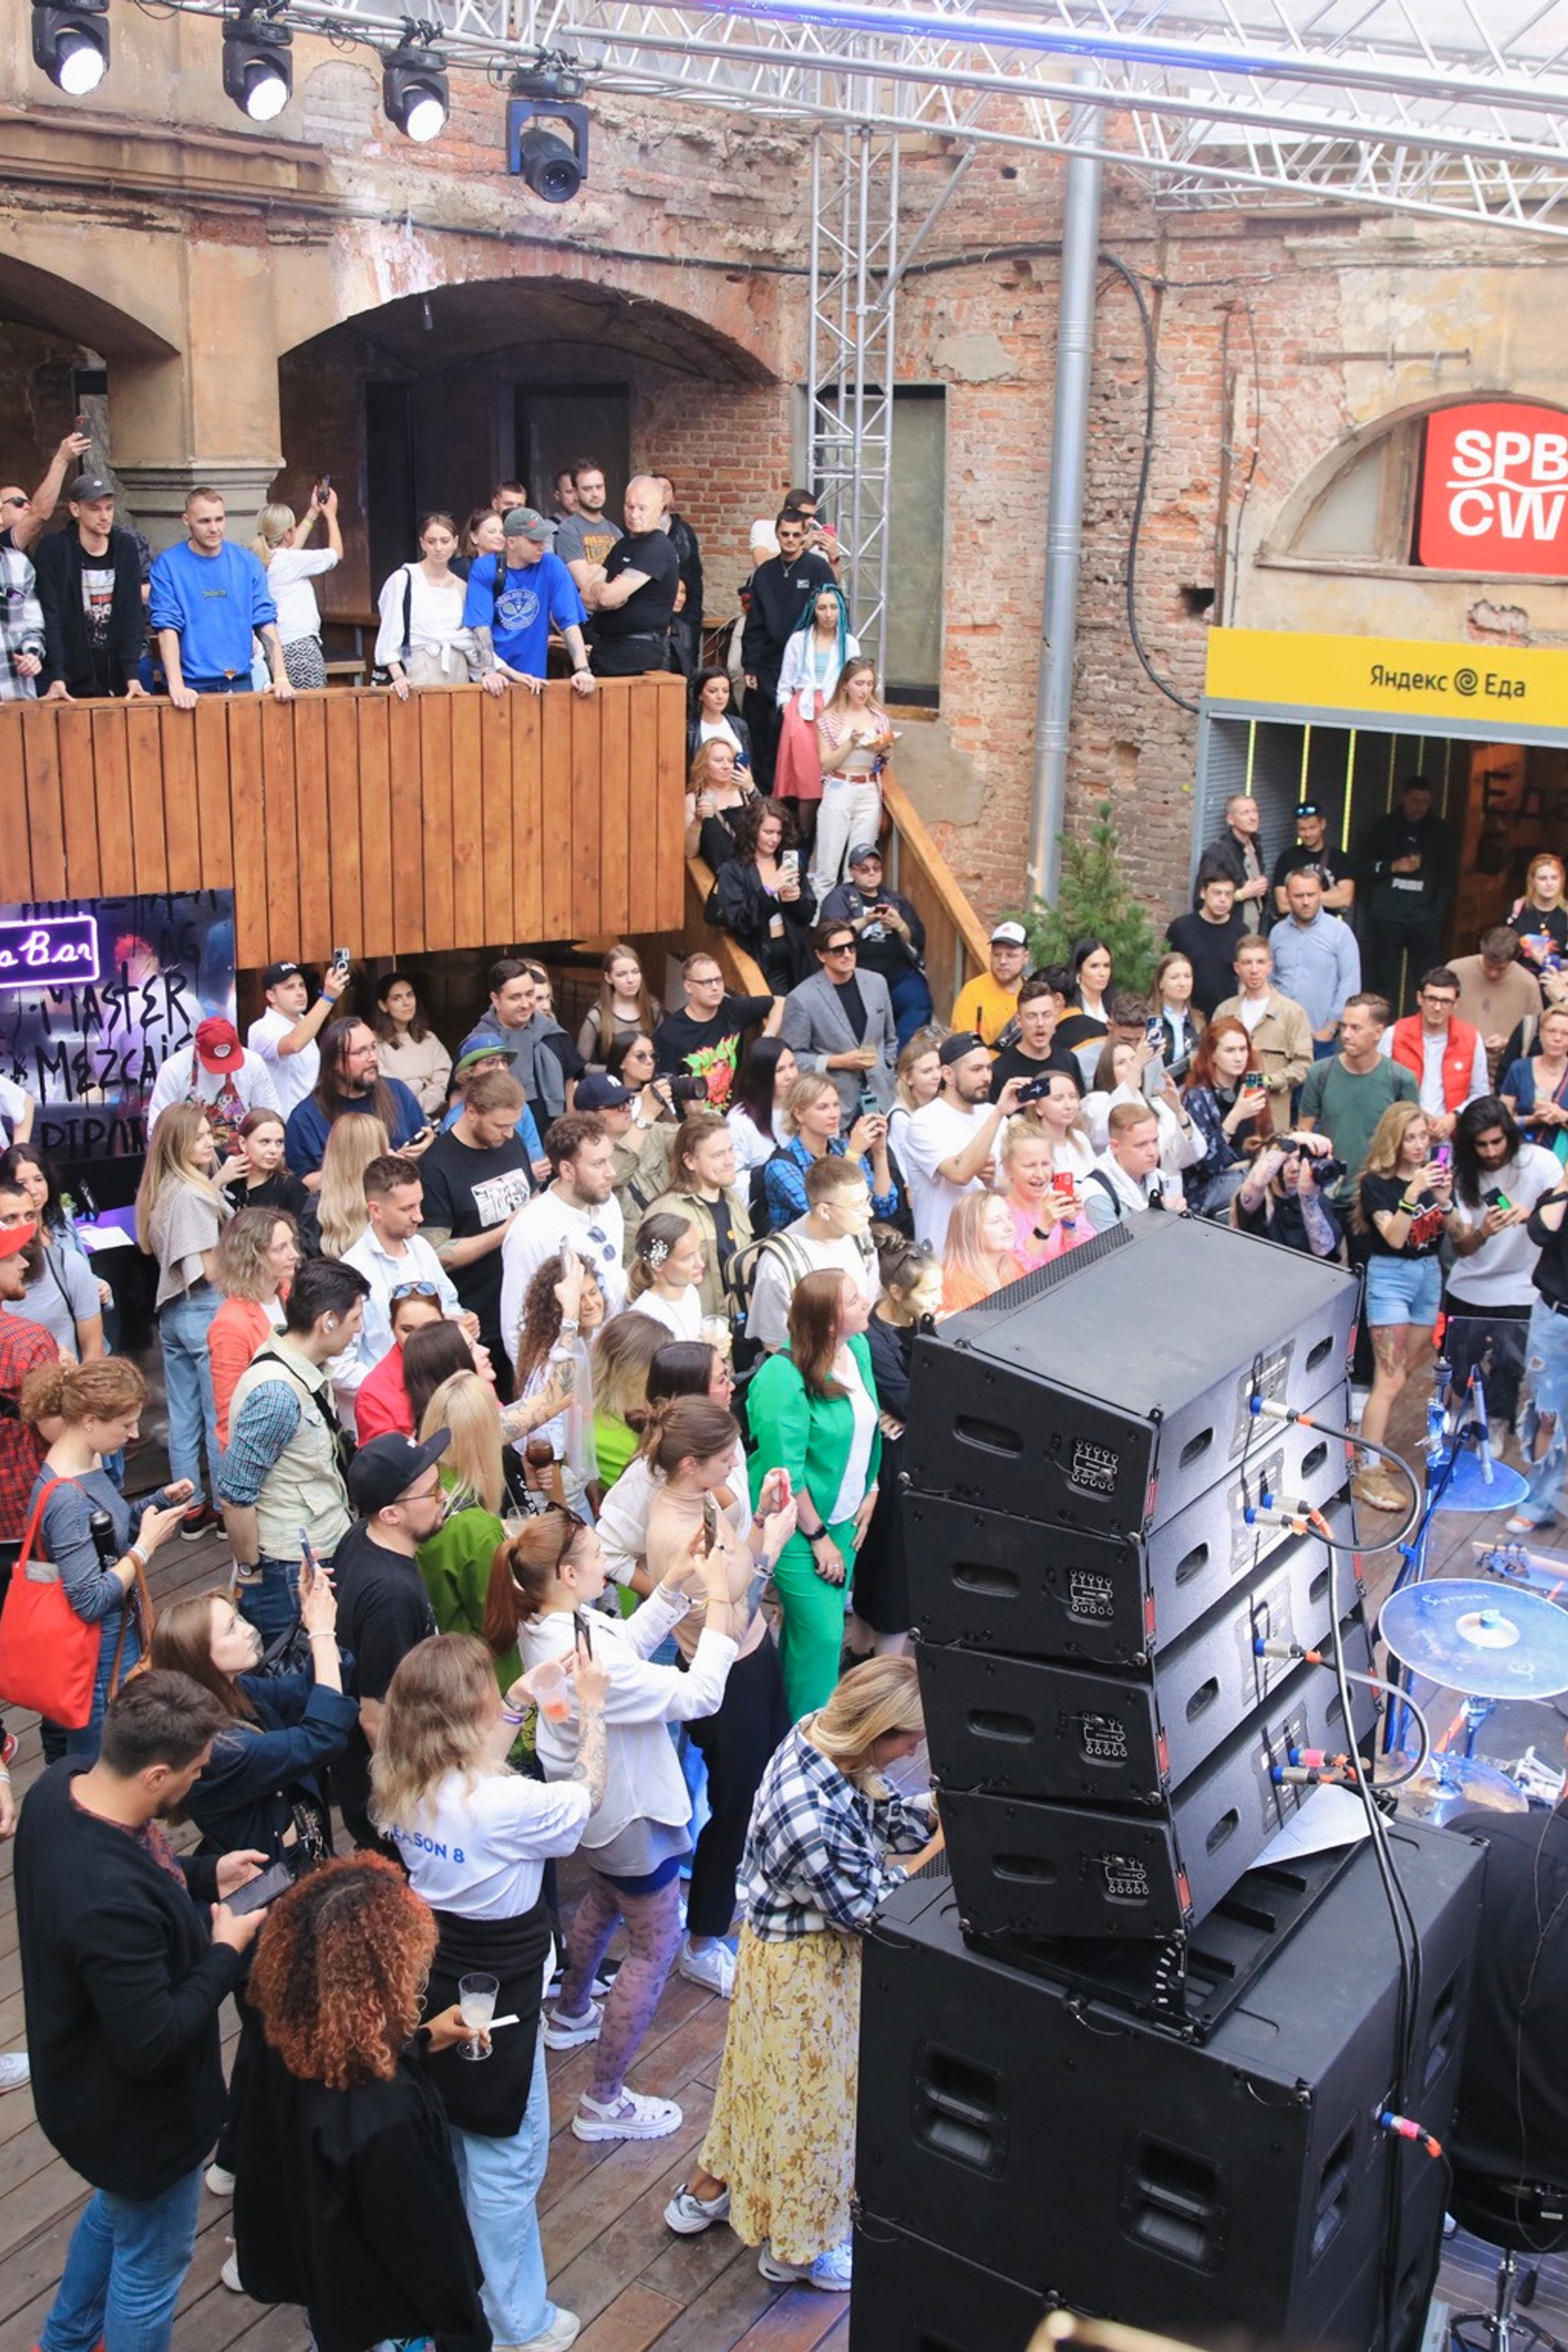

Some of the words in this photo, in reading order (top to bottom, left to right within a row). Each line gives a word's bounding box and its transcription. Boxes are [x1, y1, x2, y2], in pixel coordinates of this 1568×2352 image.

[1452, 429, 1568, 481] SPB
[1449, 489, 1566, 541] CW
[1370, 664, 1448, 692] Яндекс
[1485, 673, 1526, 699] Еда
[18, 930, 92, 966] Bar
[393, 1823, 447, 1860] EASON
[453, 1847, 465, 1863] 8
